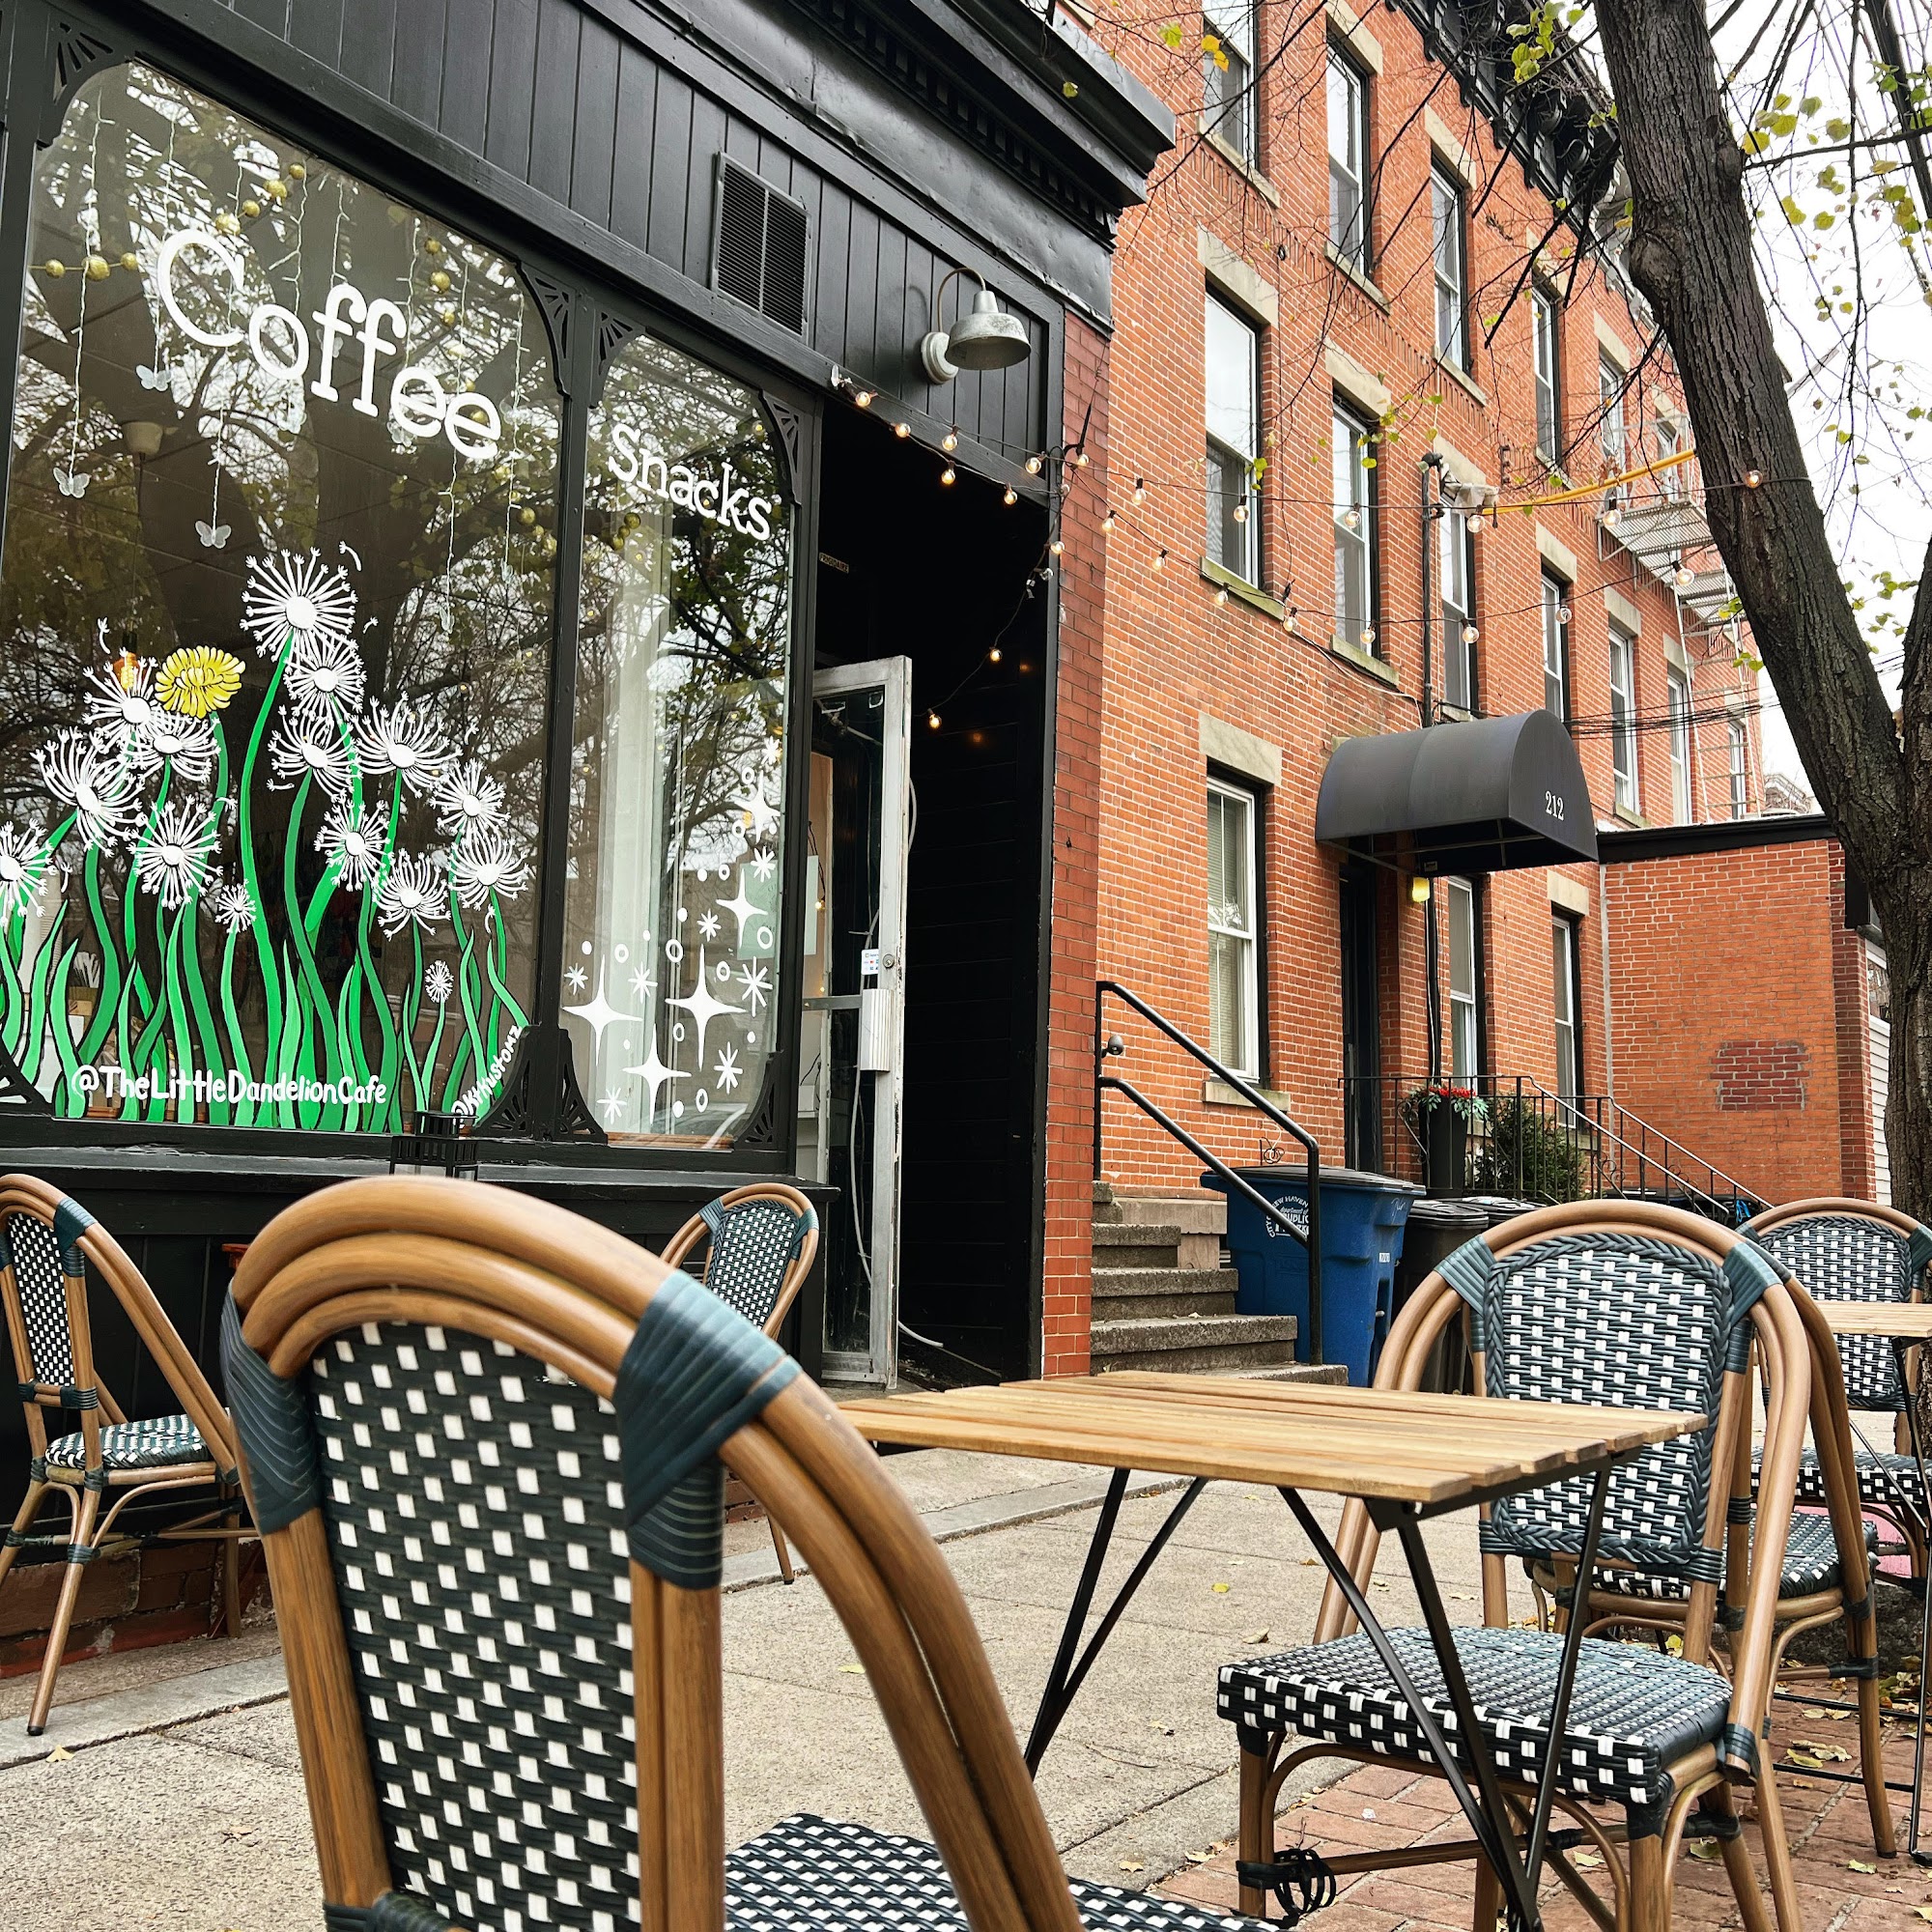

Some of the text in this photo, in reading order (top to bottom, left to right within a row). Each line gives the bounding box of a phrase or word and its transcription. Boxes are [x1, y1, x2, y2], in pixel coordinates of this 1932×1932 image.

[157, 228, 501, 459] Coffee
[608, 423, 772, 541] Snacks
[1546, 790, 1564, 821] 212
[71, 1065, 387, 1104] @TheLittleDandelionCafe
[1285, 1195, 1309, 1208] HAVEN
